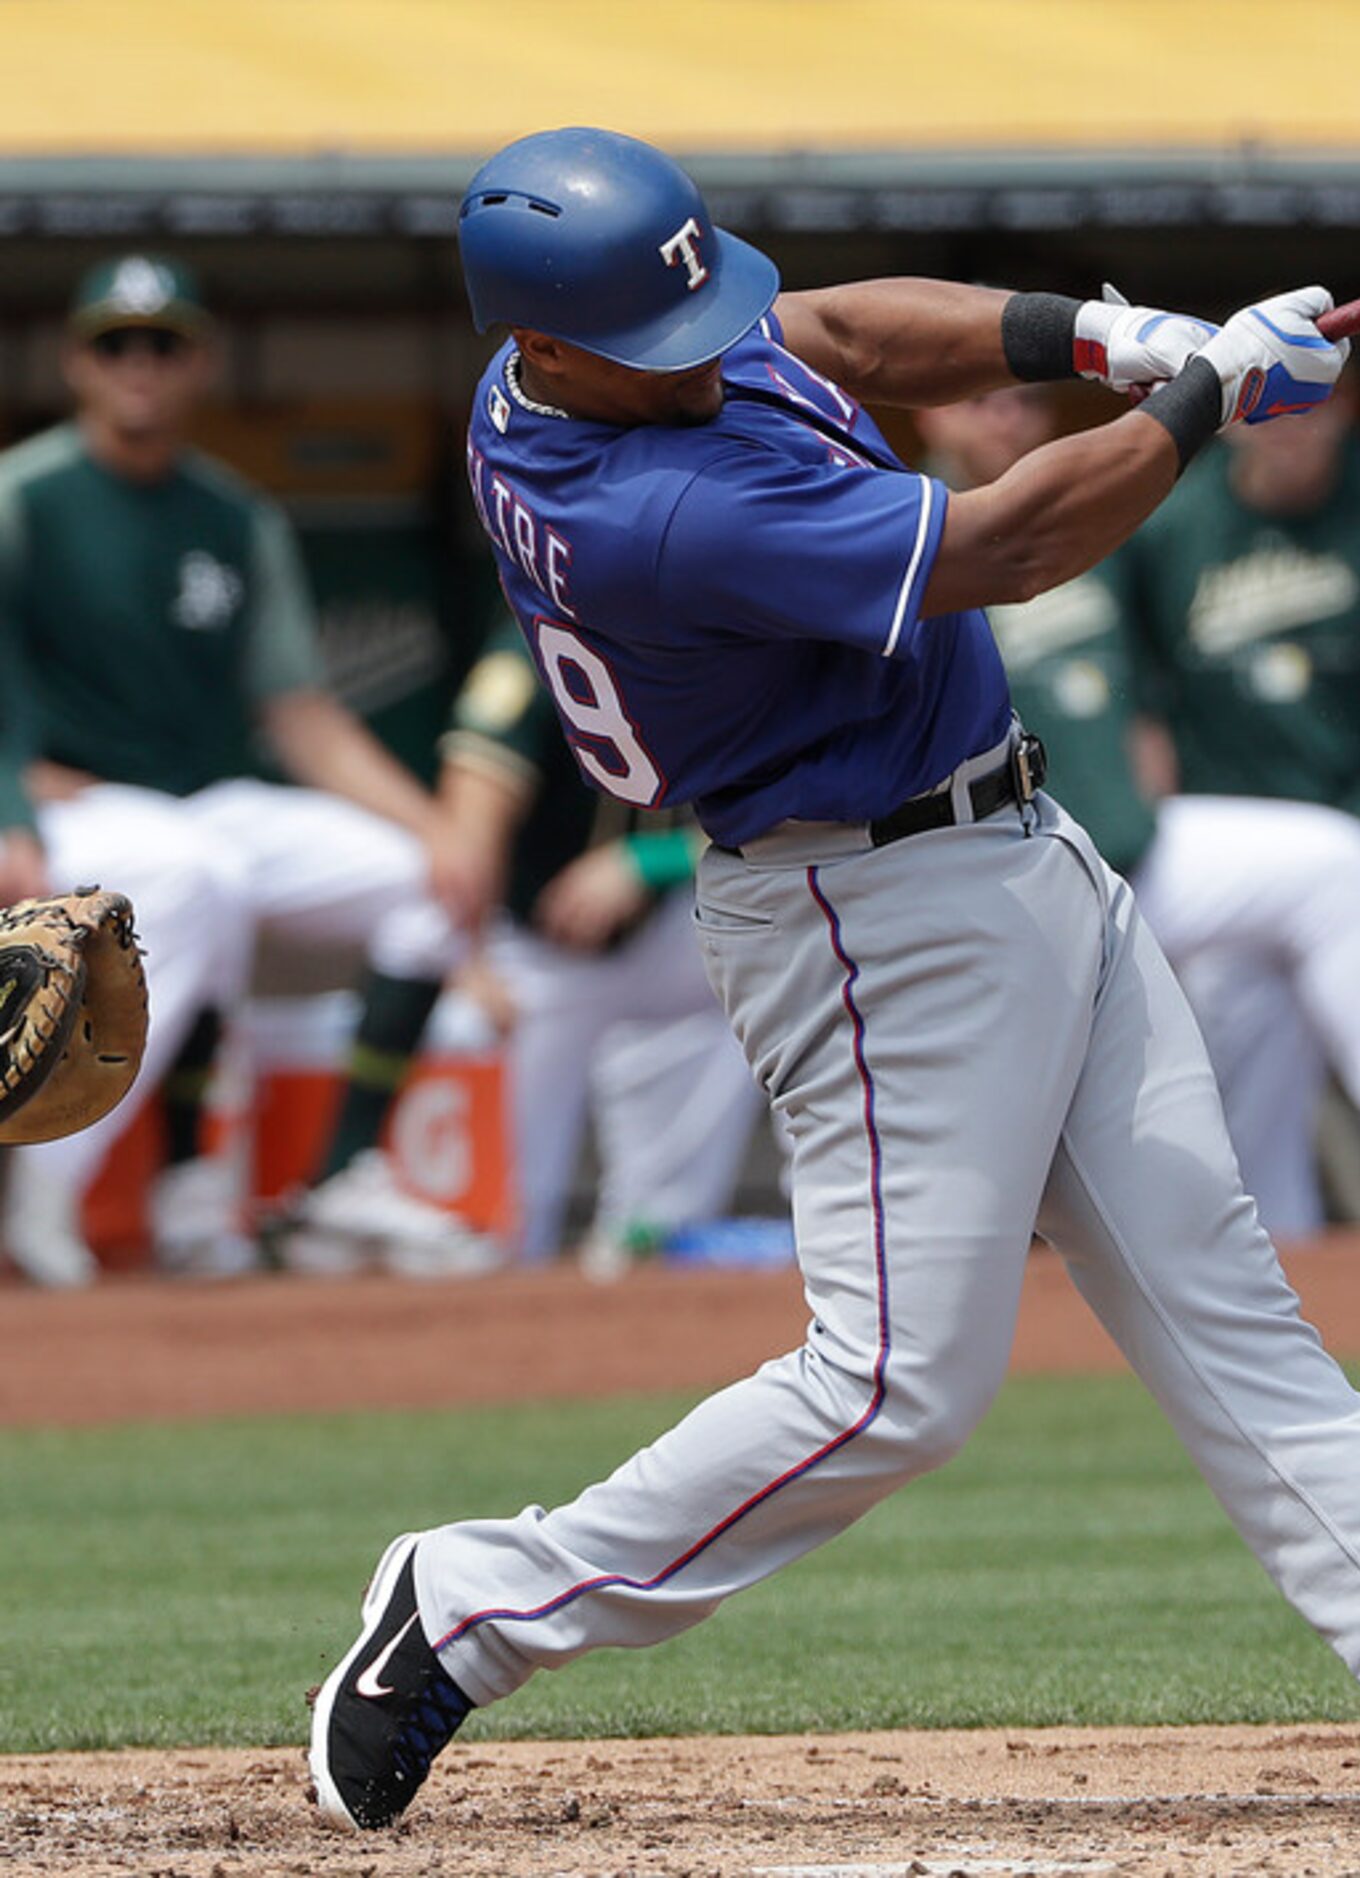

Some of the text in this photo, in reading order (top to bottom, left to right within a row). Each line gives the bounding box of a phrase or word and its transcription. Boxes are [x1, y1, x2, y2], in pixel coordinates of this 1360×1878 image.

[659, 217, 710, 291] T
[467, 438, 580, 622] LTRE
[391, 1074, 474, 1200] G
